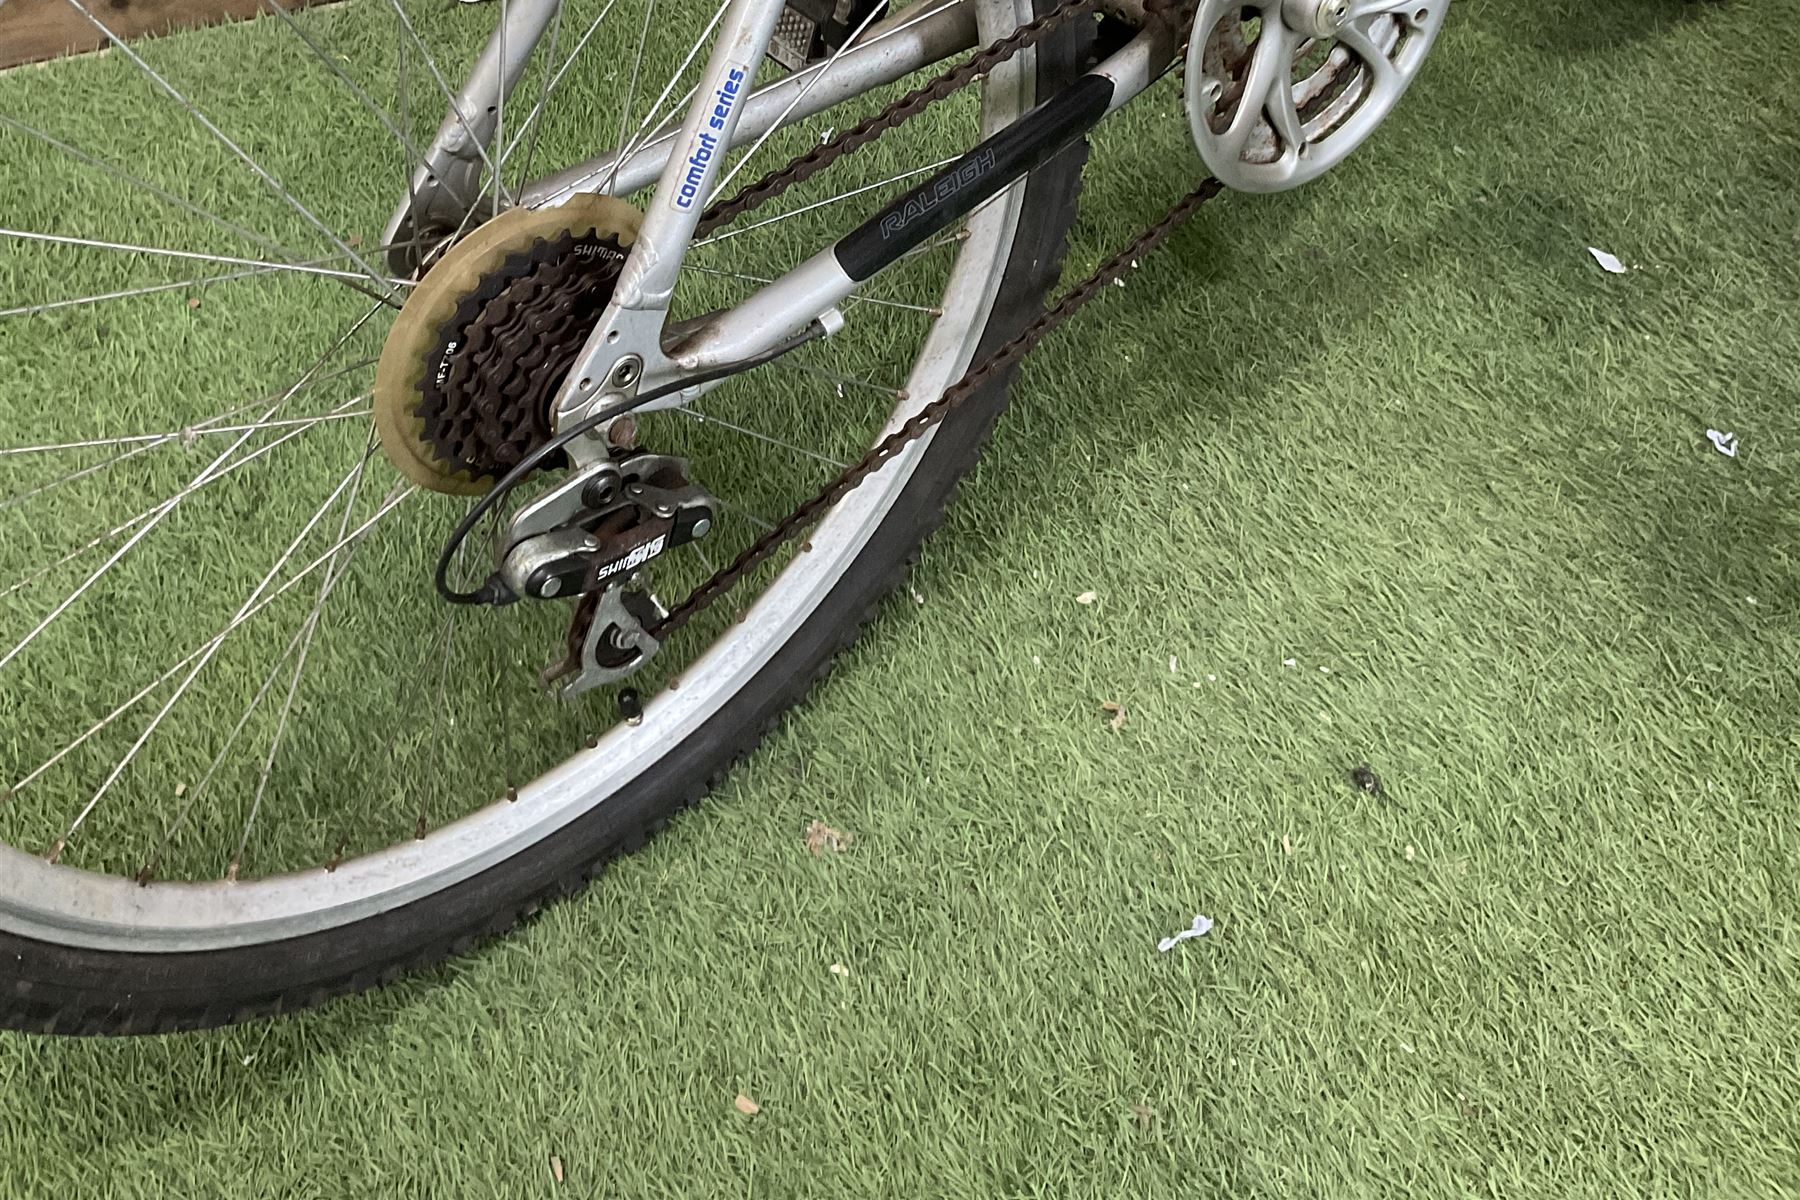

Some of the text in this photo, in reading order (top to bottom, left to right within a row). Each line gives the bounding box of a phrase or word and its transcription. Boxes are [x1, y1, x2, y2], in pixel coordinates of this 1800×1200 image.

[676, 68, 744, 208] comfort series
[880, 147, 996, 240] RALEIGH
